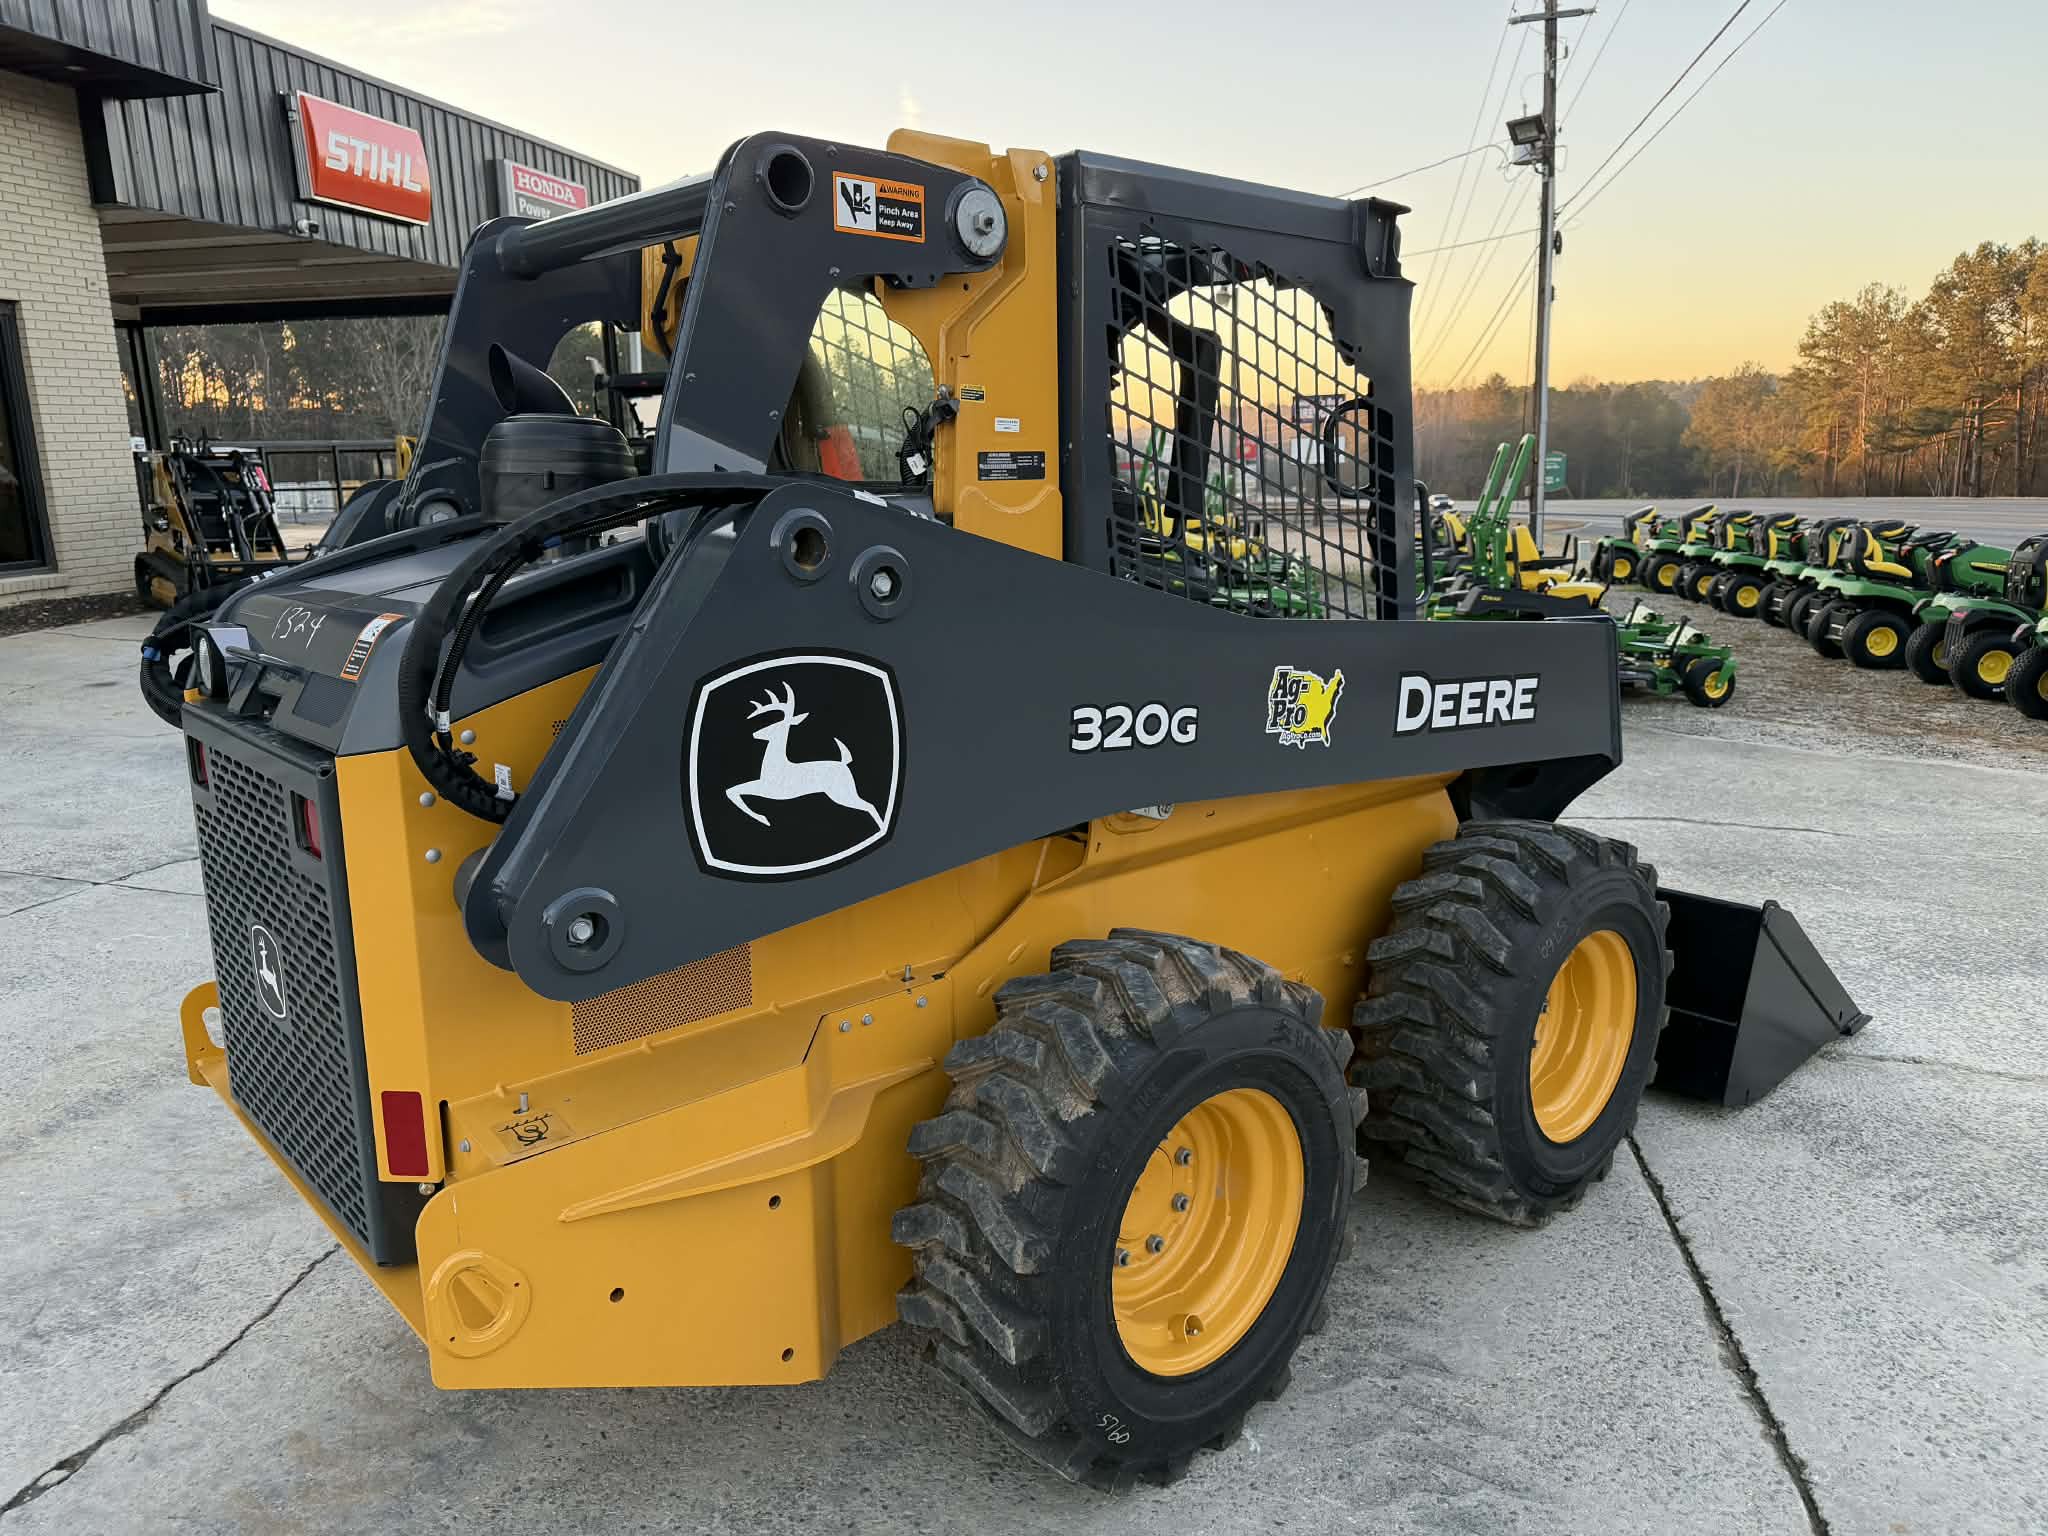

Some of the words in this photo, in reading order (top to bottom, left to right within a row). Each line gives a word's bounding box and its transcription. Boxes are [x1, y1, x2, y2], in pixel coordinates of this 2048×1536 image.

[325, 129, 422, 193] STIHL
[515, 171, 577, 204] HONDA
[886, 187, 920, 198] WARNING
[879, 204, 900, 216] Pinch
[901, 208, 919, 219] Area
[879, 217, 896, 228] Keep
[896, 220, 914, 231] Away
[272, 606, 327, 649] 1324
[1269, 699, 1307, 728] Pro
[1396, 676, 1539, 732] DEERE
[1072, 704, 1198, 751] 320G
